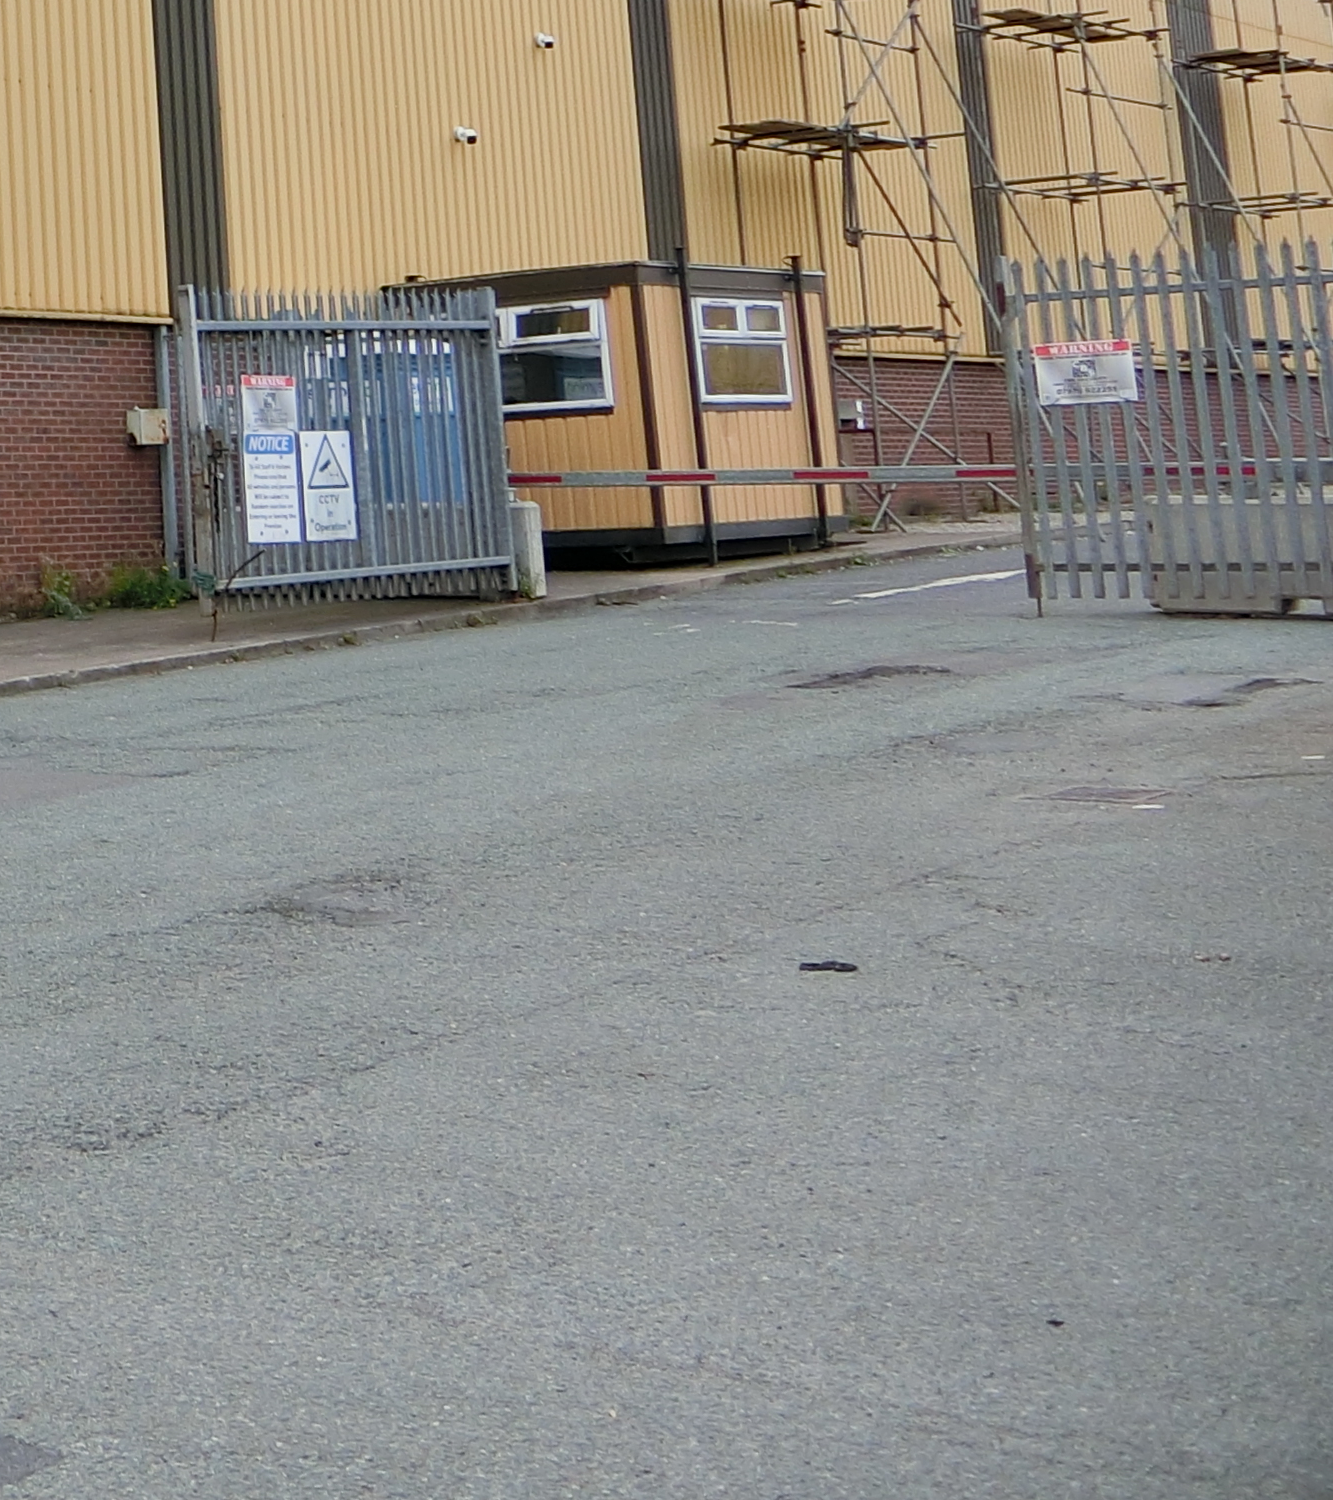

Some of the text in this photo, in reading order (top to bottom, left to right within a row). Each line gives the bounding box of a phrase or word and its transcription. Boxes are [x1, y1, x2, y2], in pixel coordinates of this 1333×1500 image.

[1048, 343, 1113, 355] WARNING
[249, 436, 290, 451] NOTICE
[318, 494, 340, 504] CCTV
[314, 522, 347, 534] Operation
